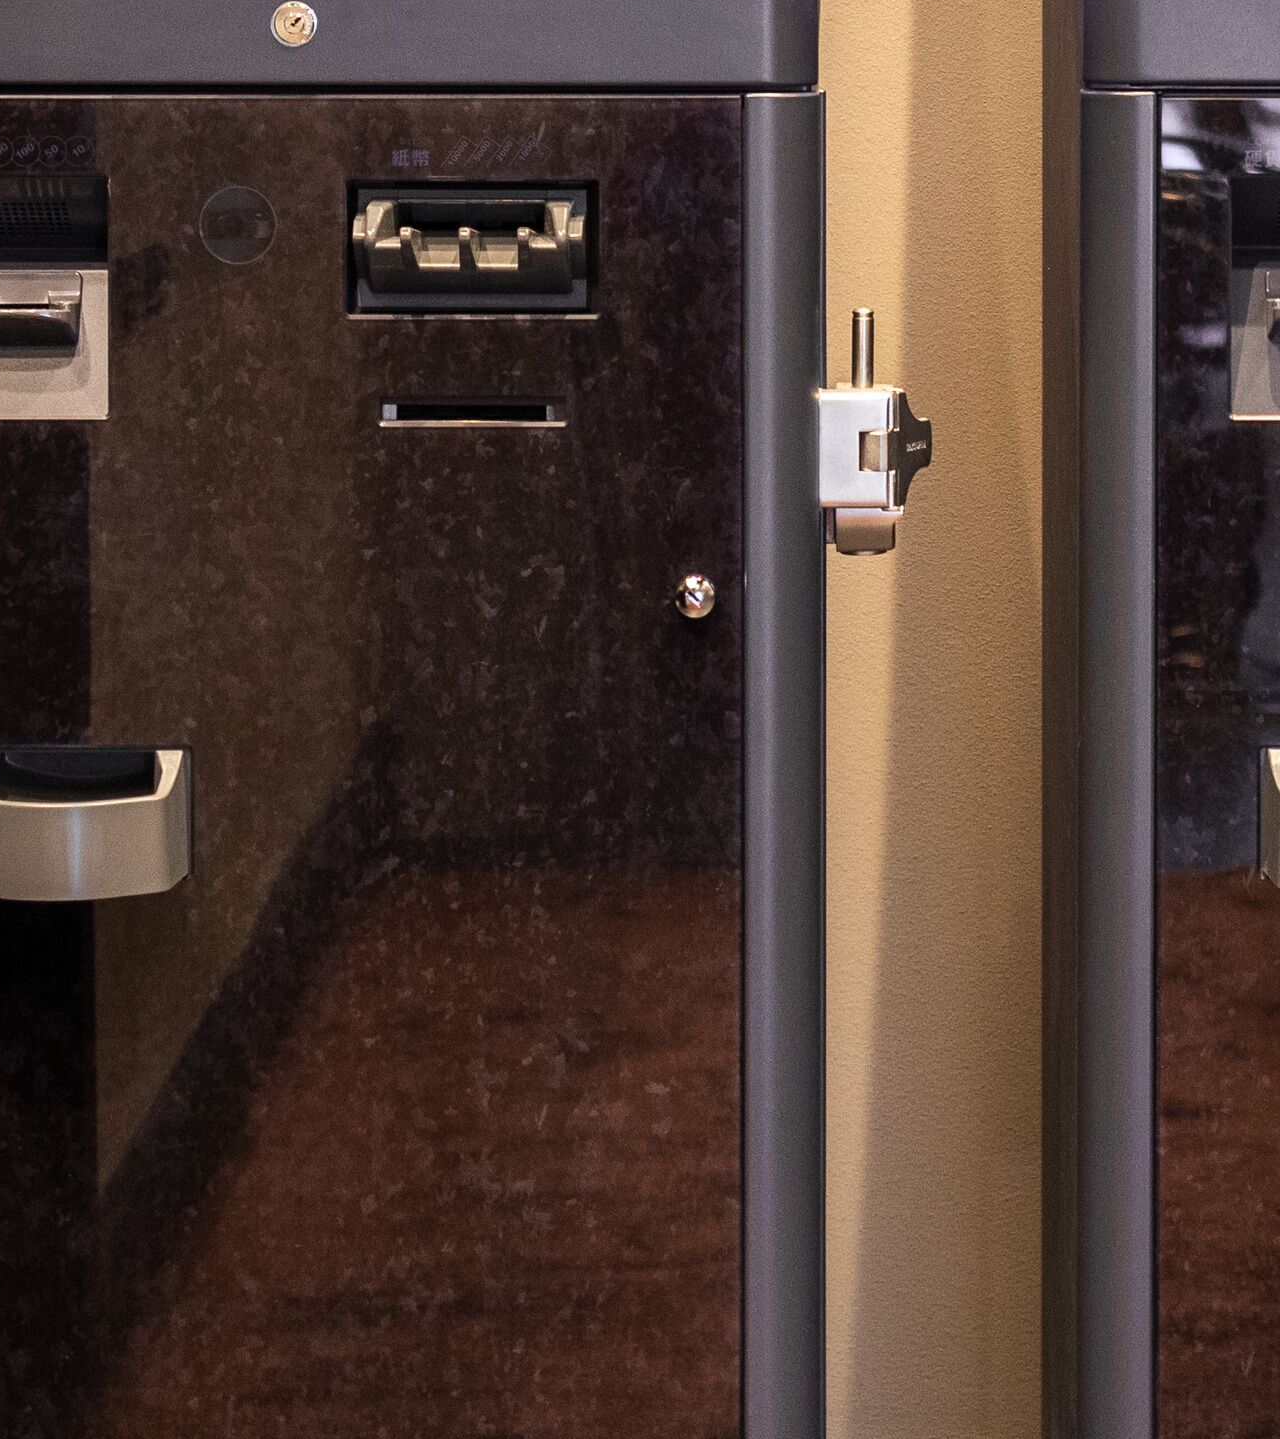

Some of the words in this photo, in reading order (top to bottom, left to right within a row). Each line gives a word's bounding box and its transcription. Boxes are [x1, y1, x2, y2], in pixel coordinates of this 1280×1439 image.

[16, 142, 35, 160] 100
[44, 144, 60, 158] 50
[72, 144, 86, 157] 10
